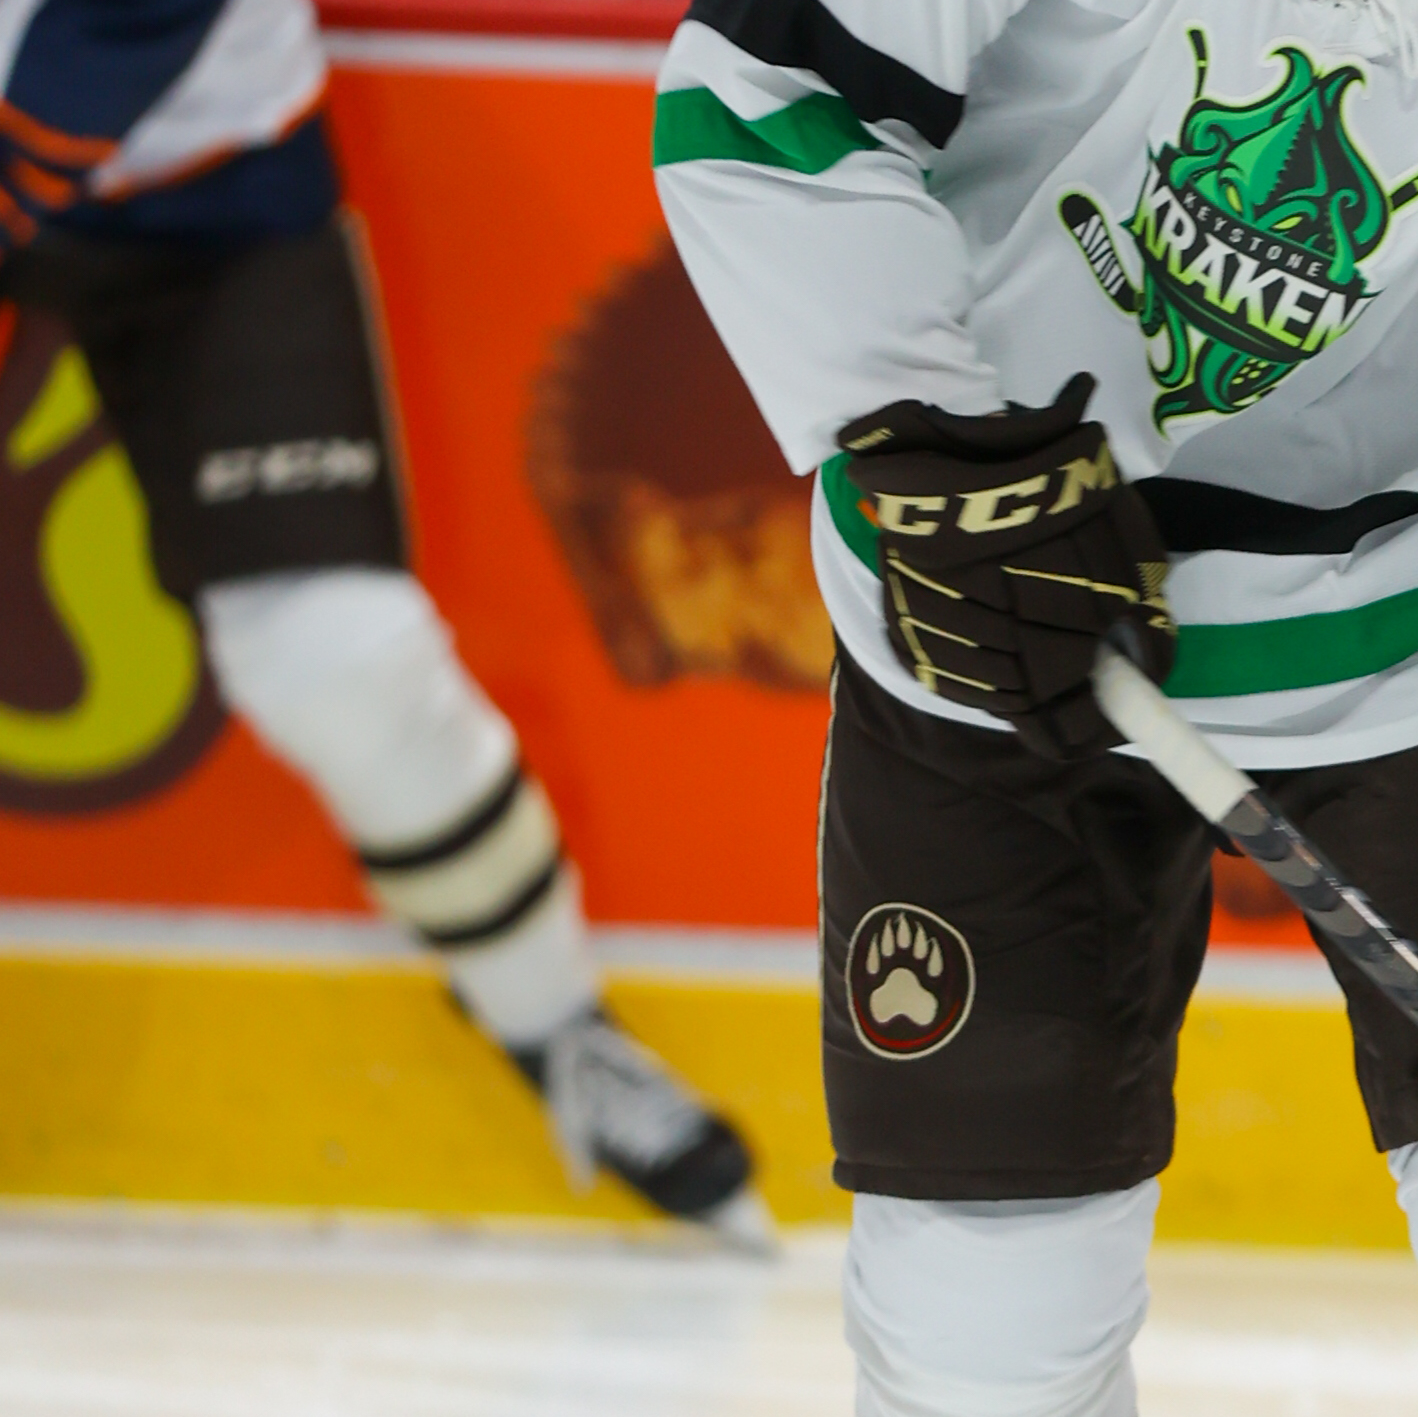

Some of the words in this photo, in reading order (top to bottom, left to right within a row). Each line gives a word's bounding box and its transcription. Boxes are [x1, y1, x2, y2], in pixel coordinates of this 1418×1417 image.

[1131, 162, 1379, 355] KRAKEN
[1183, 191, 1324, 278] KEYSTONE
[872, 440, 1116, 536] CCM
